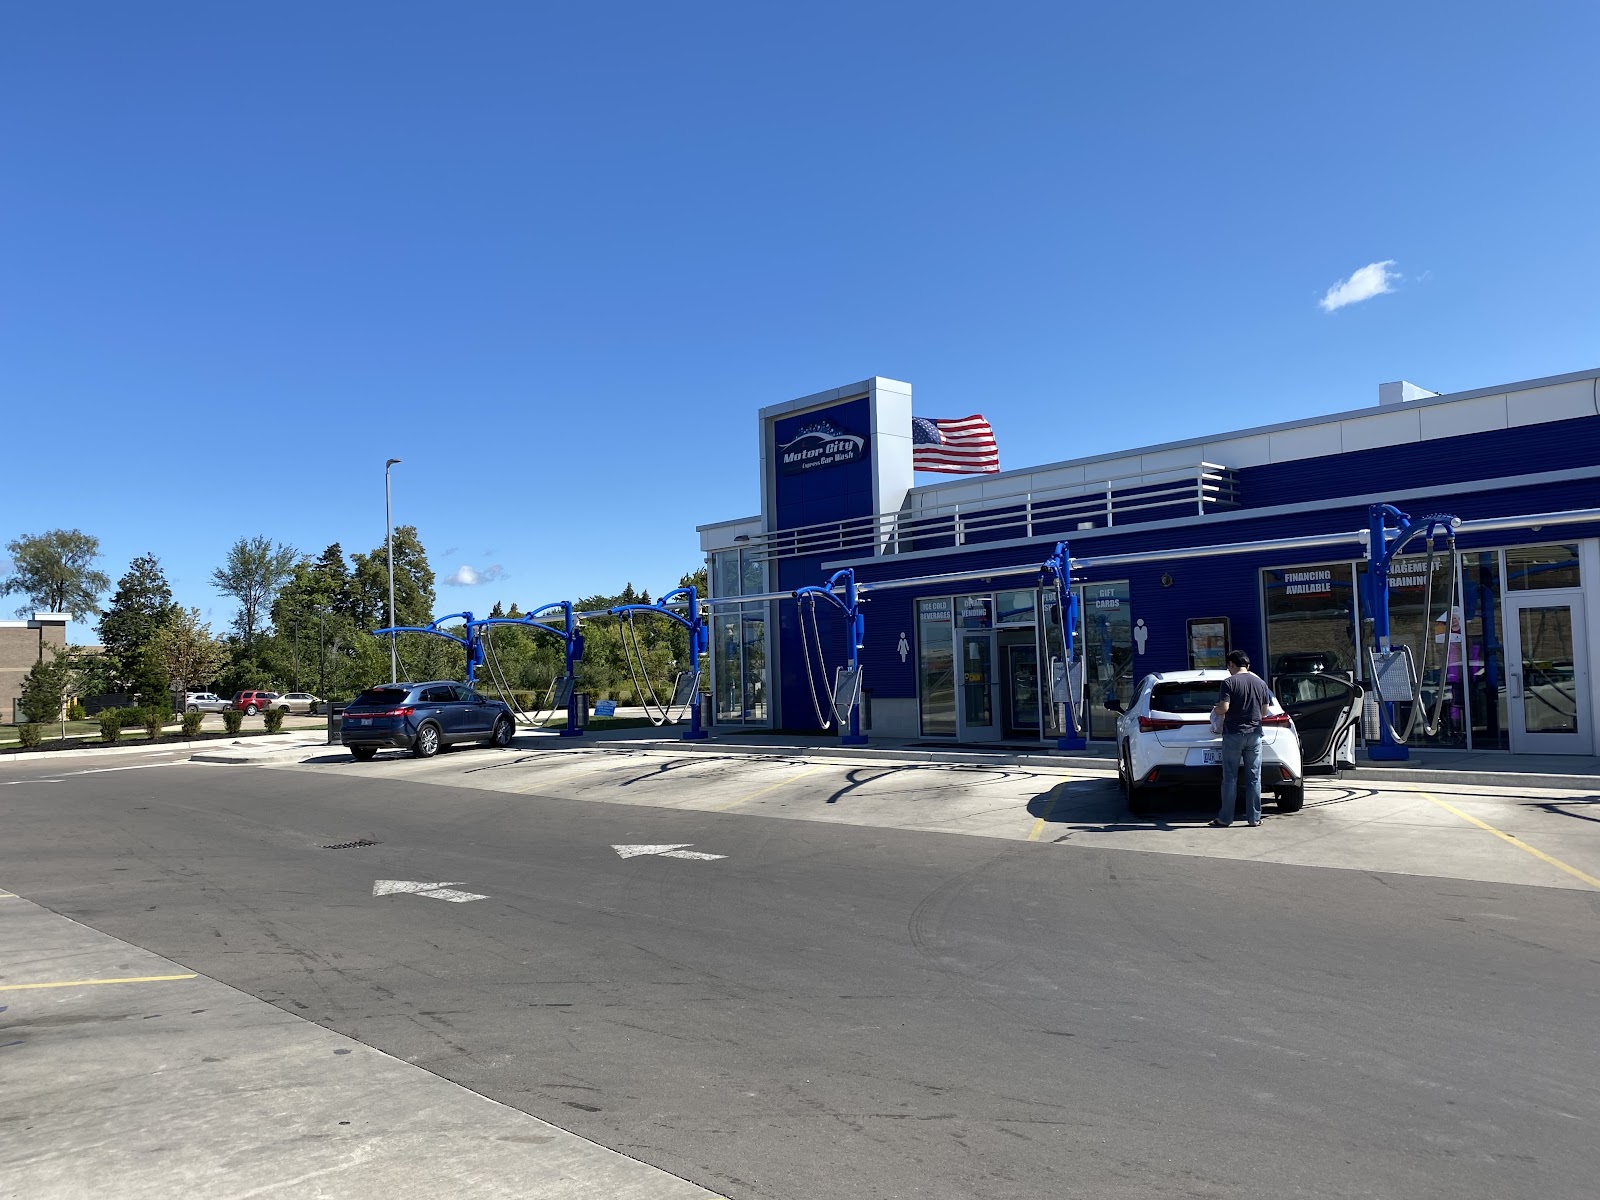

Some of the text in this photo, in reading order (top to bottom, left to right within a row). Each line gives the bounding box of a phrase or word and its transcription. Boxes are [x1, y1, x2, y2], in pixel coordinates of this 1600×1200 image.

[784, 441, 853, 463] Motor City
[835, 451, 853, 461] Wash
[1390, 562, 1440, 574] NAGEMET
[1285, 571, 1331, 582] FINANCING
[1100, 589, 1114, 597] GIFT
[1286, 583, 1331, 594] AVAILABLE
[933, 602, 946, 610] COLD
[1096, 600, 1119, 608] CARDS
[962, 609, 986, 617] VENDING
